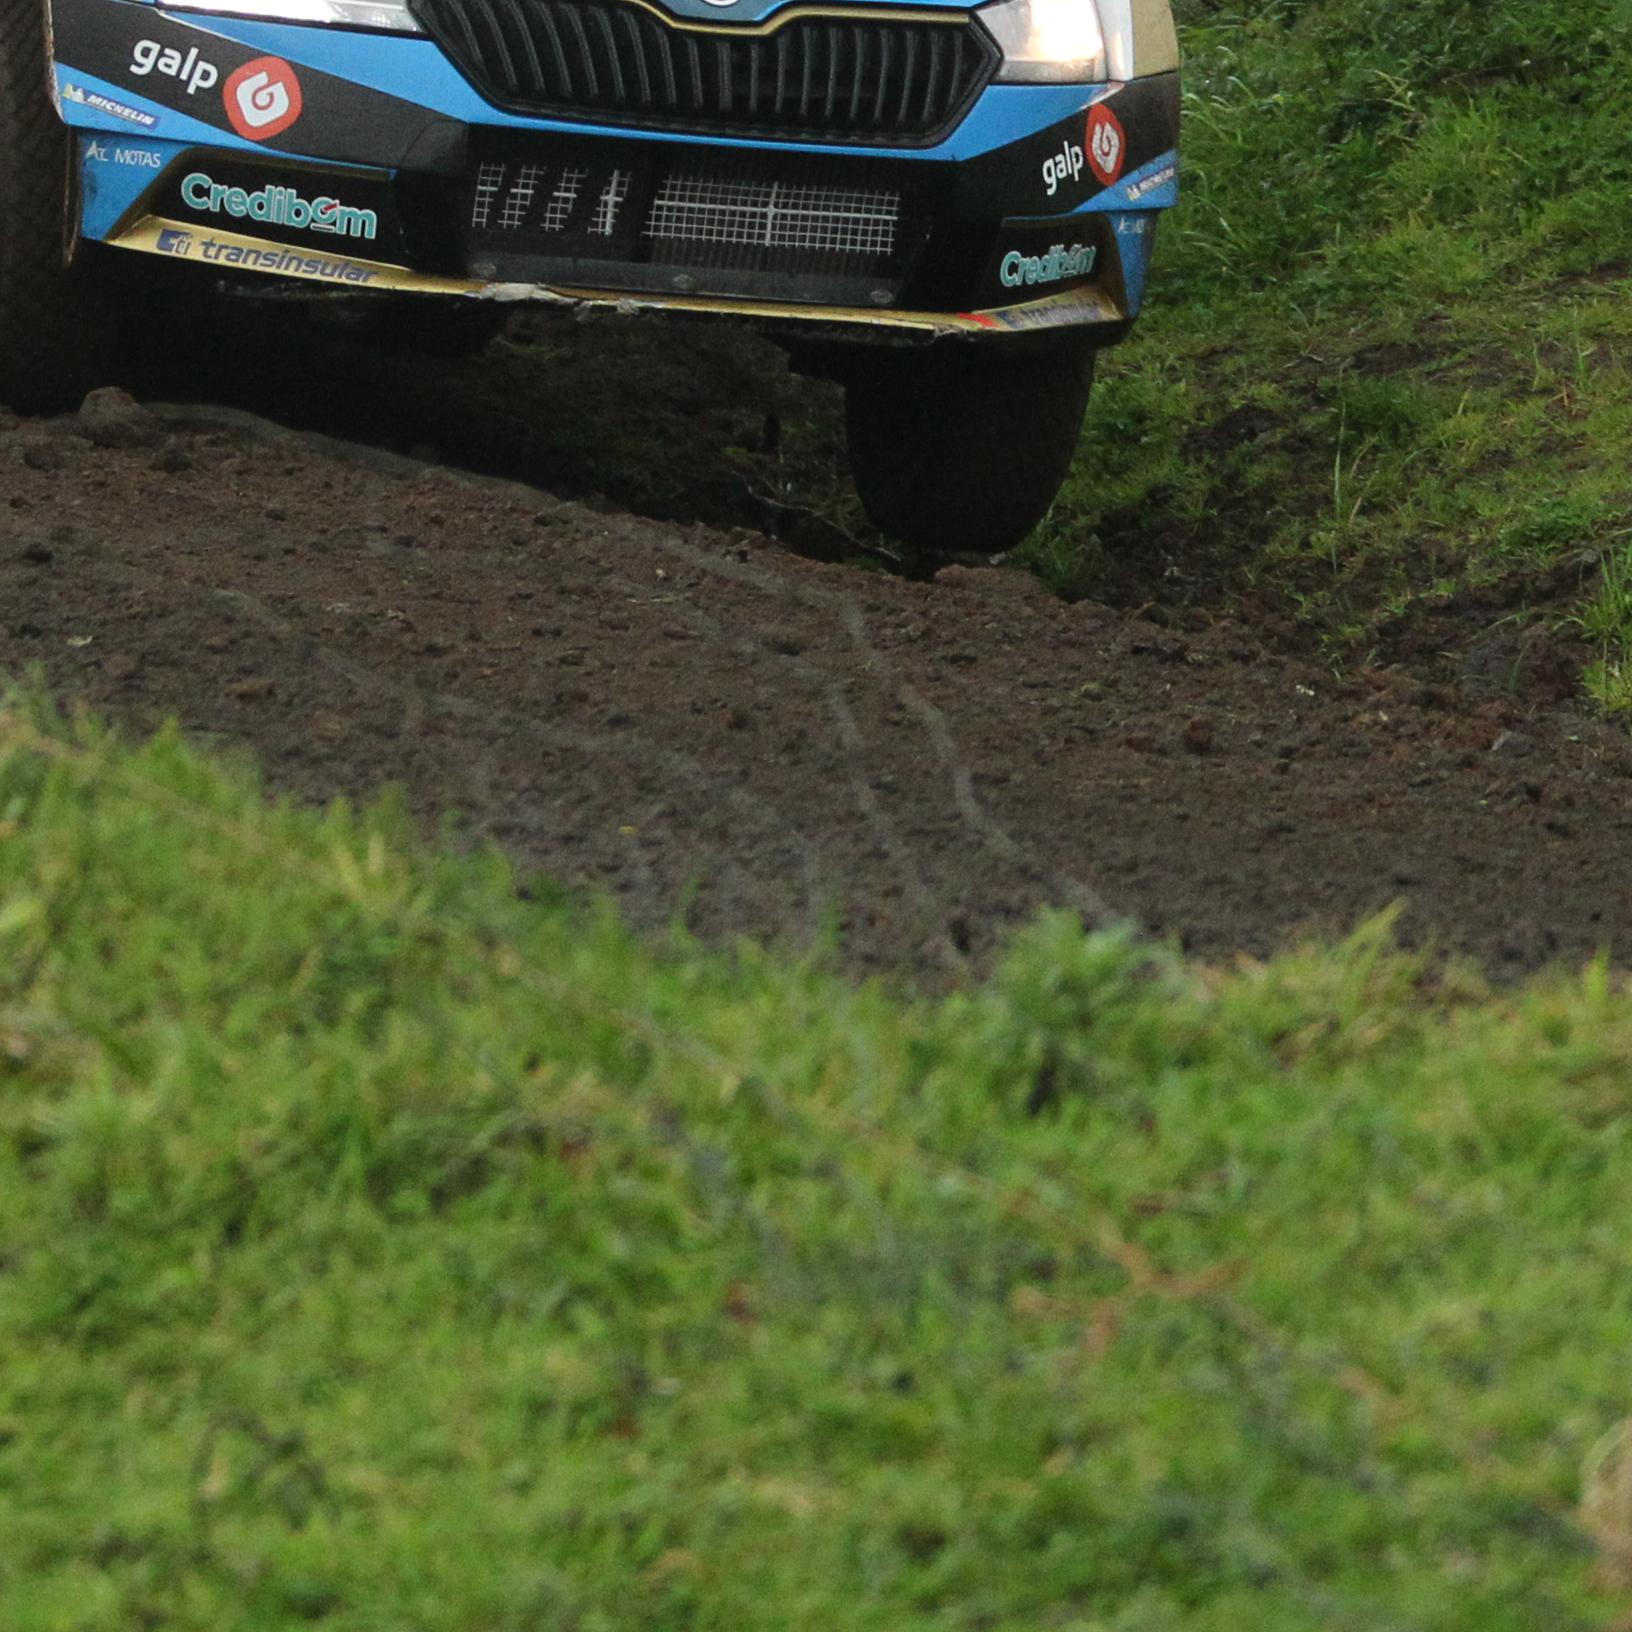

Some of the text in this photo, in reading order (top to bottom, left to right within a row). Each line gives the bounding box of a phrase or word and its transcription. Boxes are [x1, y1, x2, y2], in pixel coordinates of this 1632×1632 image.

[129, 38, 219, 94] galp
[87, 95, 156, 126] MICHELIN
[115, 148, 161, 168] MOTAS
[1042, 141, 1084, 196] galp
[181, 172, 377, 239] Credibom
[199, 238, 379, 283] transinsular
